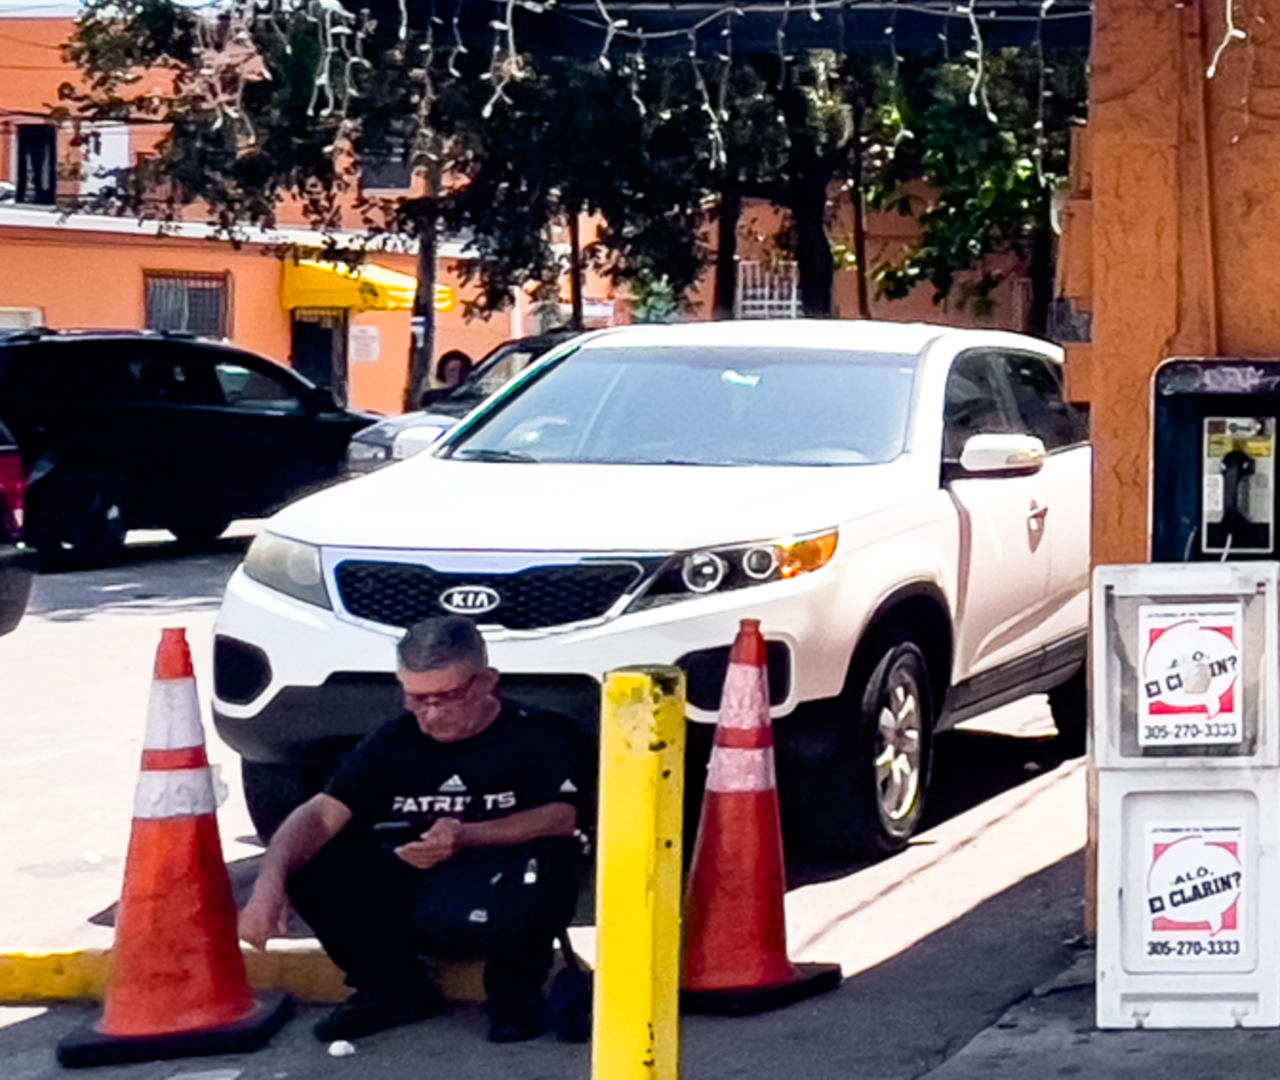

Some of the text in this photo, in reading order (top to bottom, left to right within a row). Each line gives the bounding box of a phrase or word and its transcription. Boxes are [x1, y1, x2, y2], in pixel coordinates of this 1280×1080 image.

[452, 592, 489, 607] KIA
[1165, 654, 1238, 692] CLIN?
[392, 792, 517, 813] PATRITS
[1146, 940, 1241, 956] 305-270-3333
